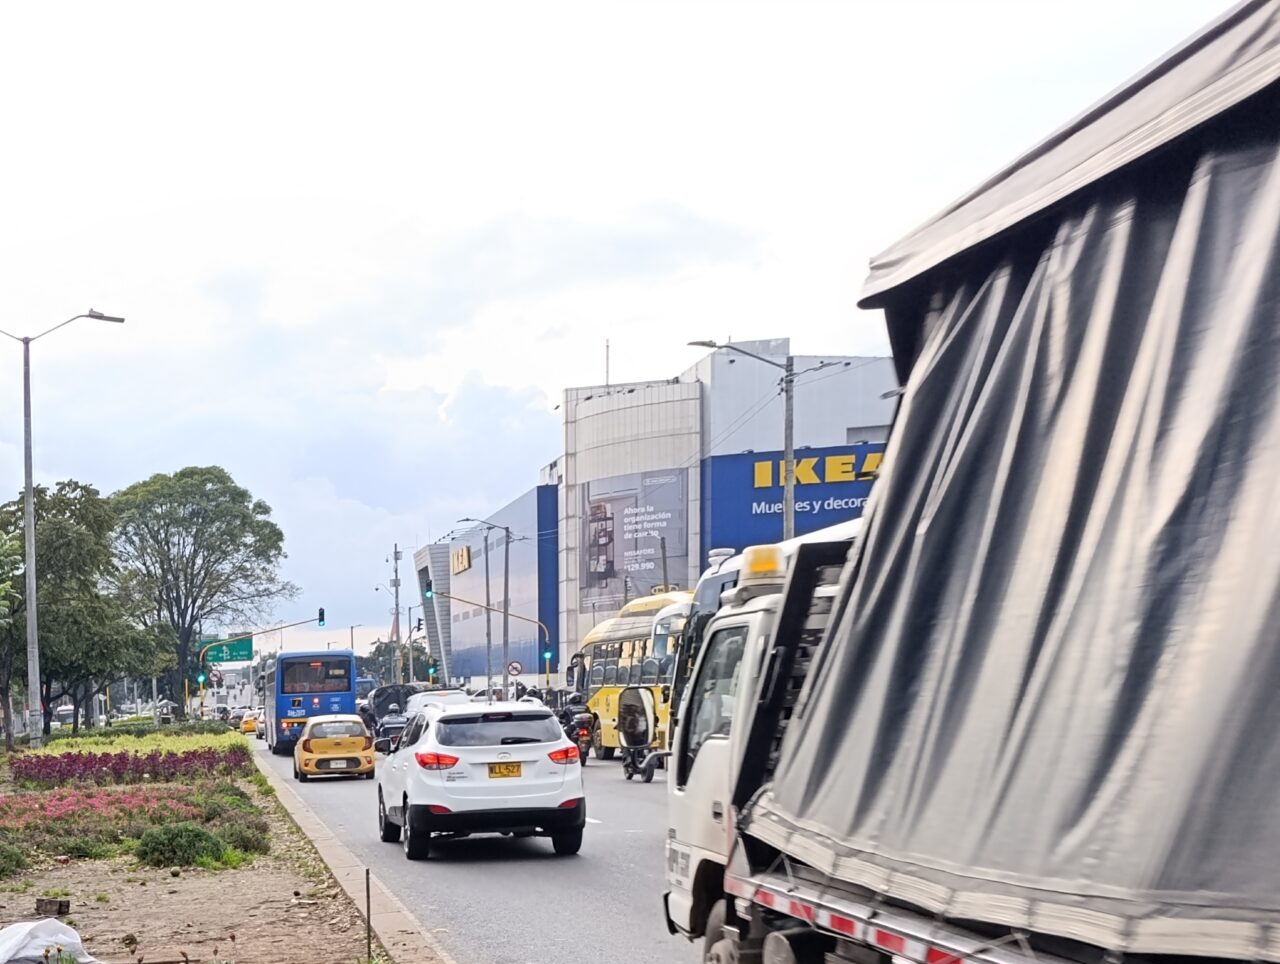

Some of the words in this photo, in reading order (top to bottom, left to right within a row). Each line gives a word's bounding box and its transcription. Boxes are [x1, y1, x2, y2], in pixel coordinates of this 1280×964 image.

[624, 507, 645, 515] Ahora
[752, 500, 810, 514] Muees
[812, 500, 821, 514] y
[624, 512, 671, 523] organización
[624, 523, 642, 531] tiene
[643, 521, 667, 529] forma
[452, 546, 470, 575] IKEA
